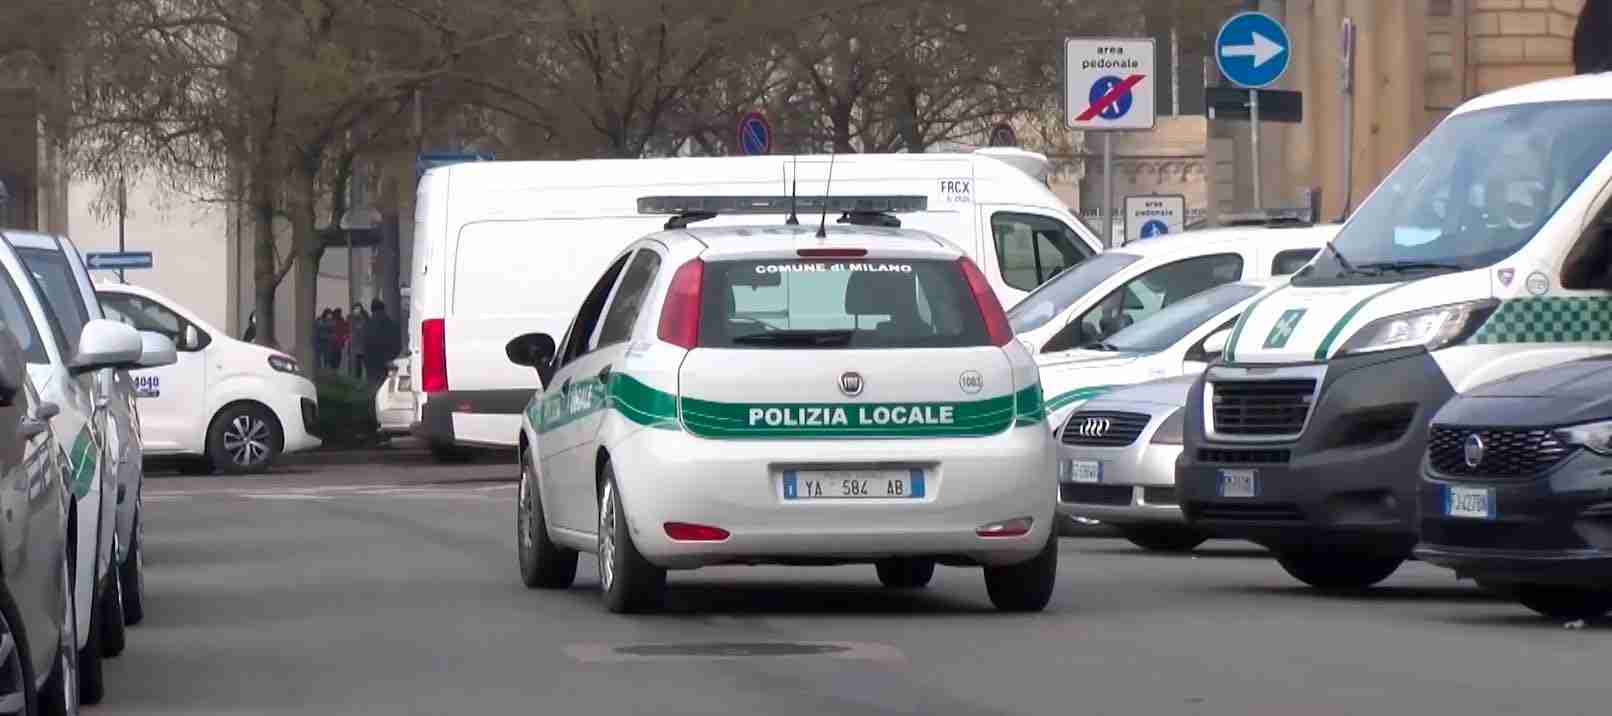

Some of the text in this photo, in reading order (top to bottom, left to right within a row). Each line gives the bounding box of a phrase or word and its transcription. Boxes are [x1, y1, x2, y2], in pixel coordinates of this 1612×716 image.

[1097, 46, 1123, 55] area
[1081, 59, 1138, 70] pedonale
[940, 180, 970, 193] FRCX
[755, 263, 827, 274] COMUNE
[849, 262, 913, 273] MILANO
[748, 405, 955, 427] POLIZIA LOCALE
[805, 479, 823, 496] YA
[842, 479, 868, 495] 584
[887, 479, 904, 495] AB
